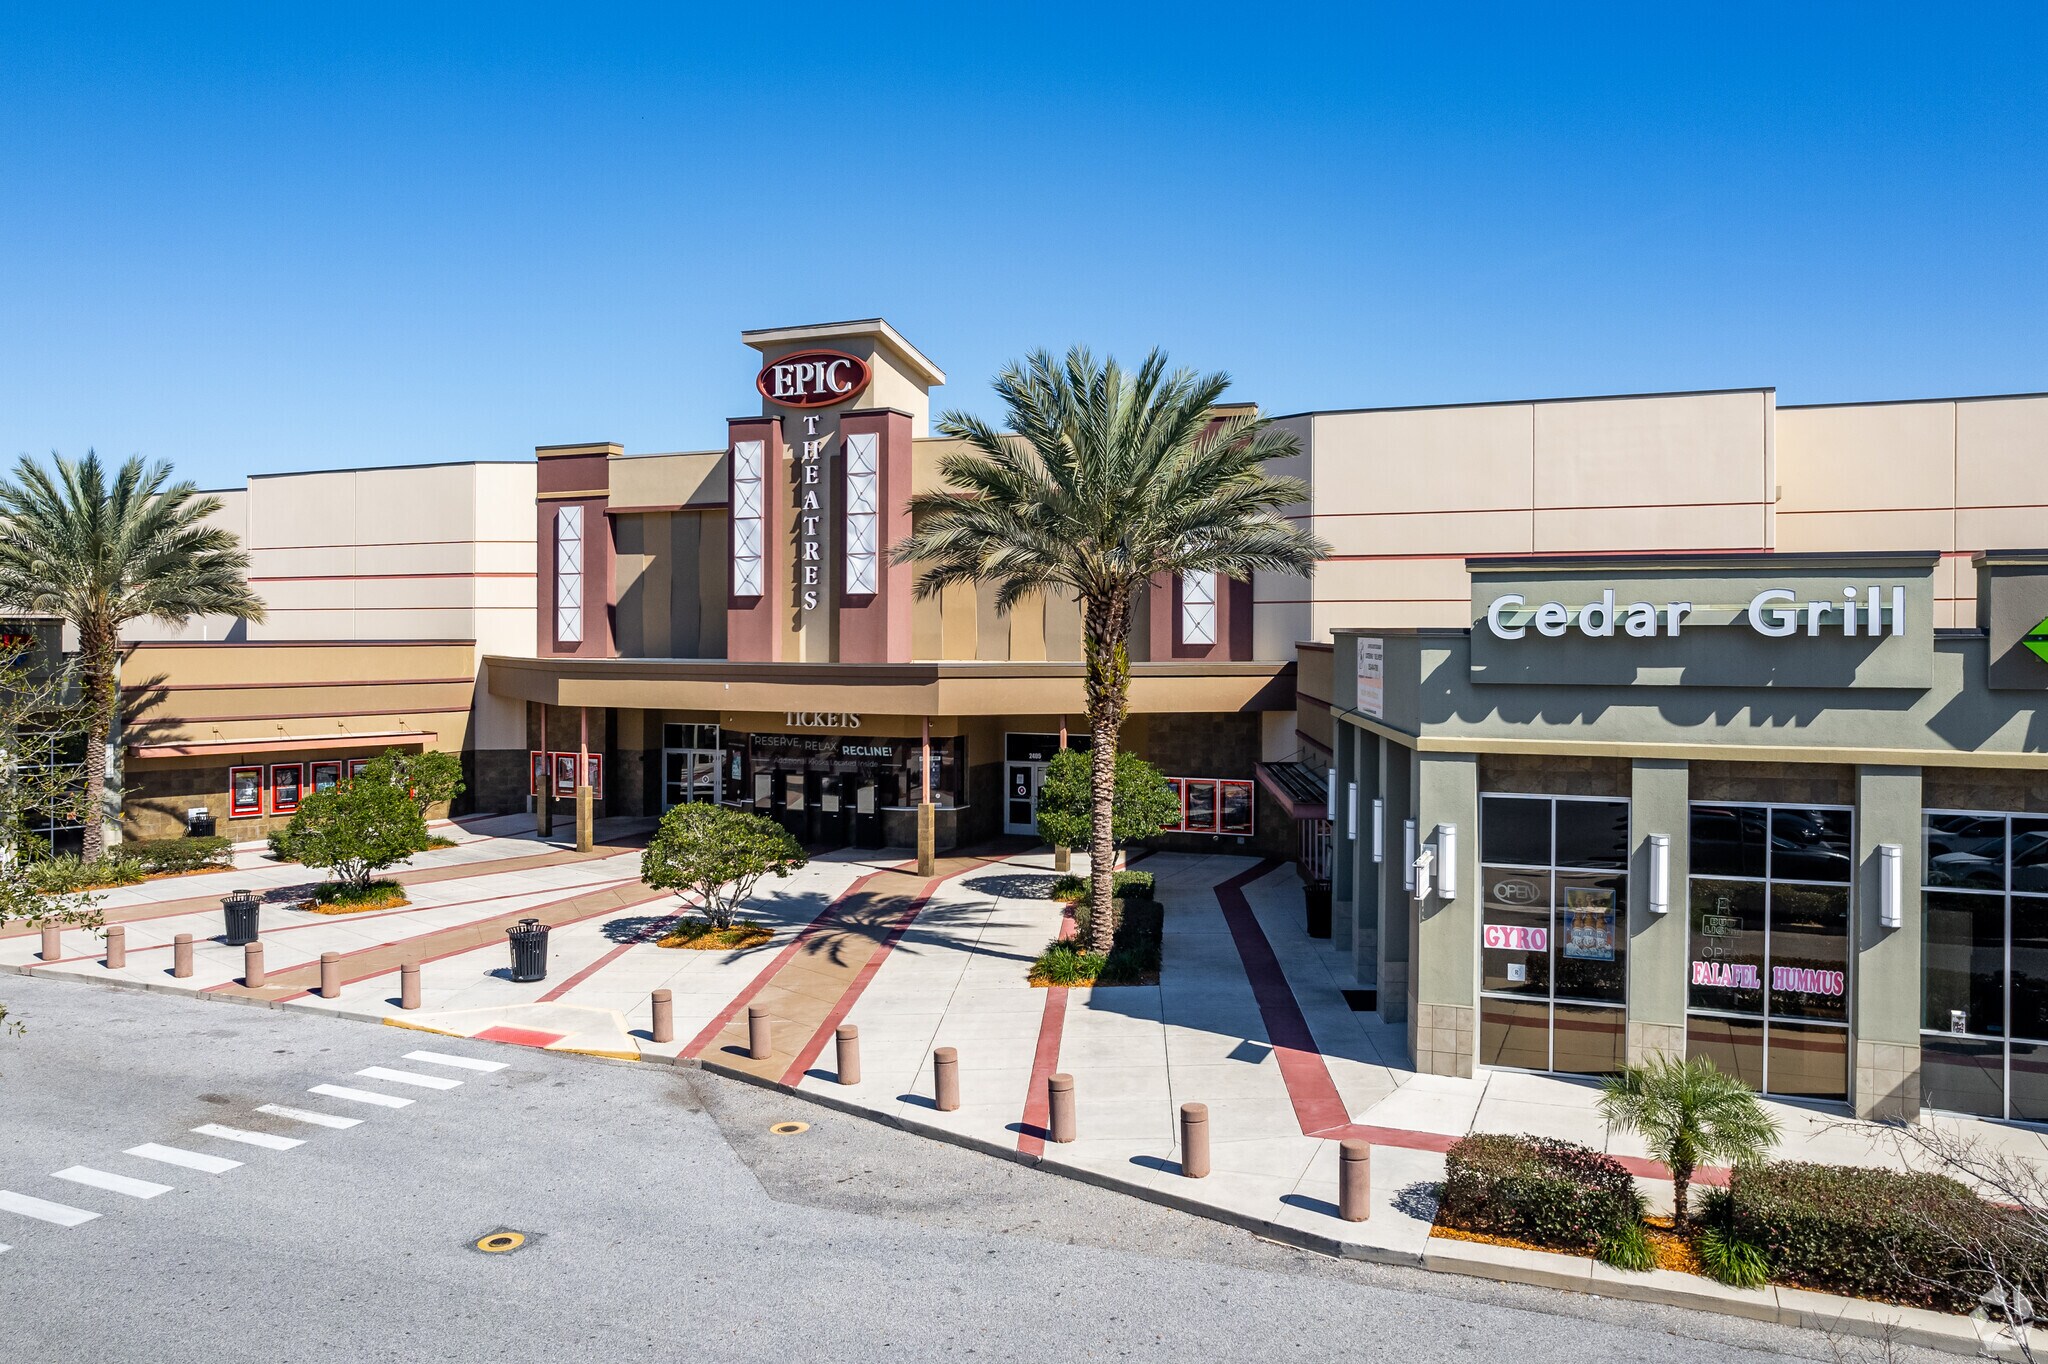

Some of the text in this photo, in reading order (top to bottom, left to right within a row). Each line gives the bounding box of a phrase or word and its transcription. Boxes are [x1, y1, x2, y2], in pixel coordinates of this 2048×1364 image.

[772, 359, 852, 397] EPIC
[802, 414, 821, 611] THEATRES
[1487, 585, 1906, 640] Cedar Grill
[783, 711, 861, 729] TICKETS
[755, 736, 802, 748] RESERVE,
[805, 740, 839, 752] RELAX,
[842, 745, 893, 757] RECLINE!
[1496, 884, 1535, 899] OPEN
[1709, 917, 1736, 927] BUD
[1485, 925, 1547, 950] GYRO
[1702, 946, 1743, 959] OPEN
[1693, 961, 1844, 996] FALAFEL HUMMUS
